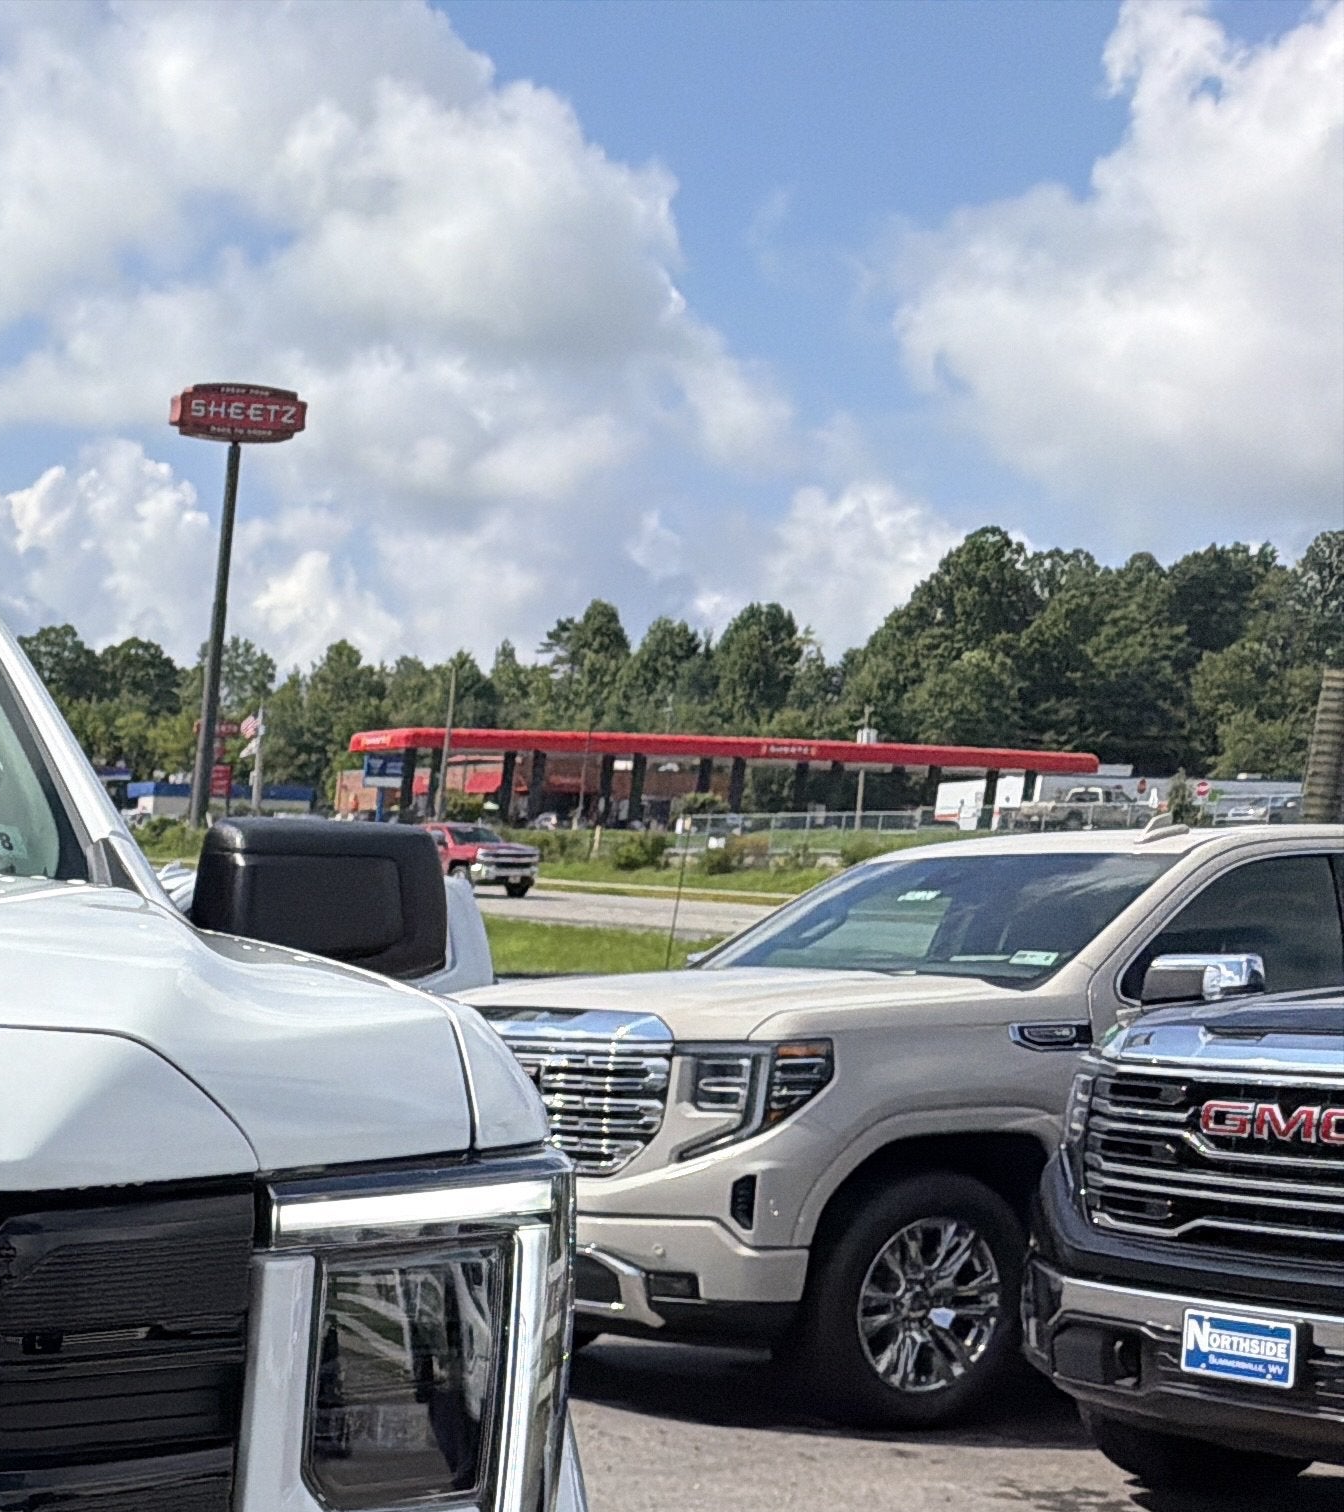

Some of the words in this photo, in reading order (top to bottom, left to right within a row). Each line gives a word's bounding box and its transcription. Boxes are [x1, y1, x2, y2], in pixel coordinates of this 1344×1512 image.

[191, 400, 297, 424] SHEETZ
[1186, 1318, 1288, 1359] NORTHSIDE
[1268, 1364, 1284, 1375] WV
